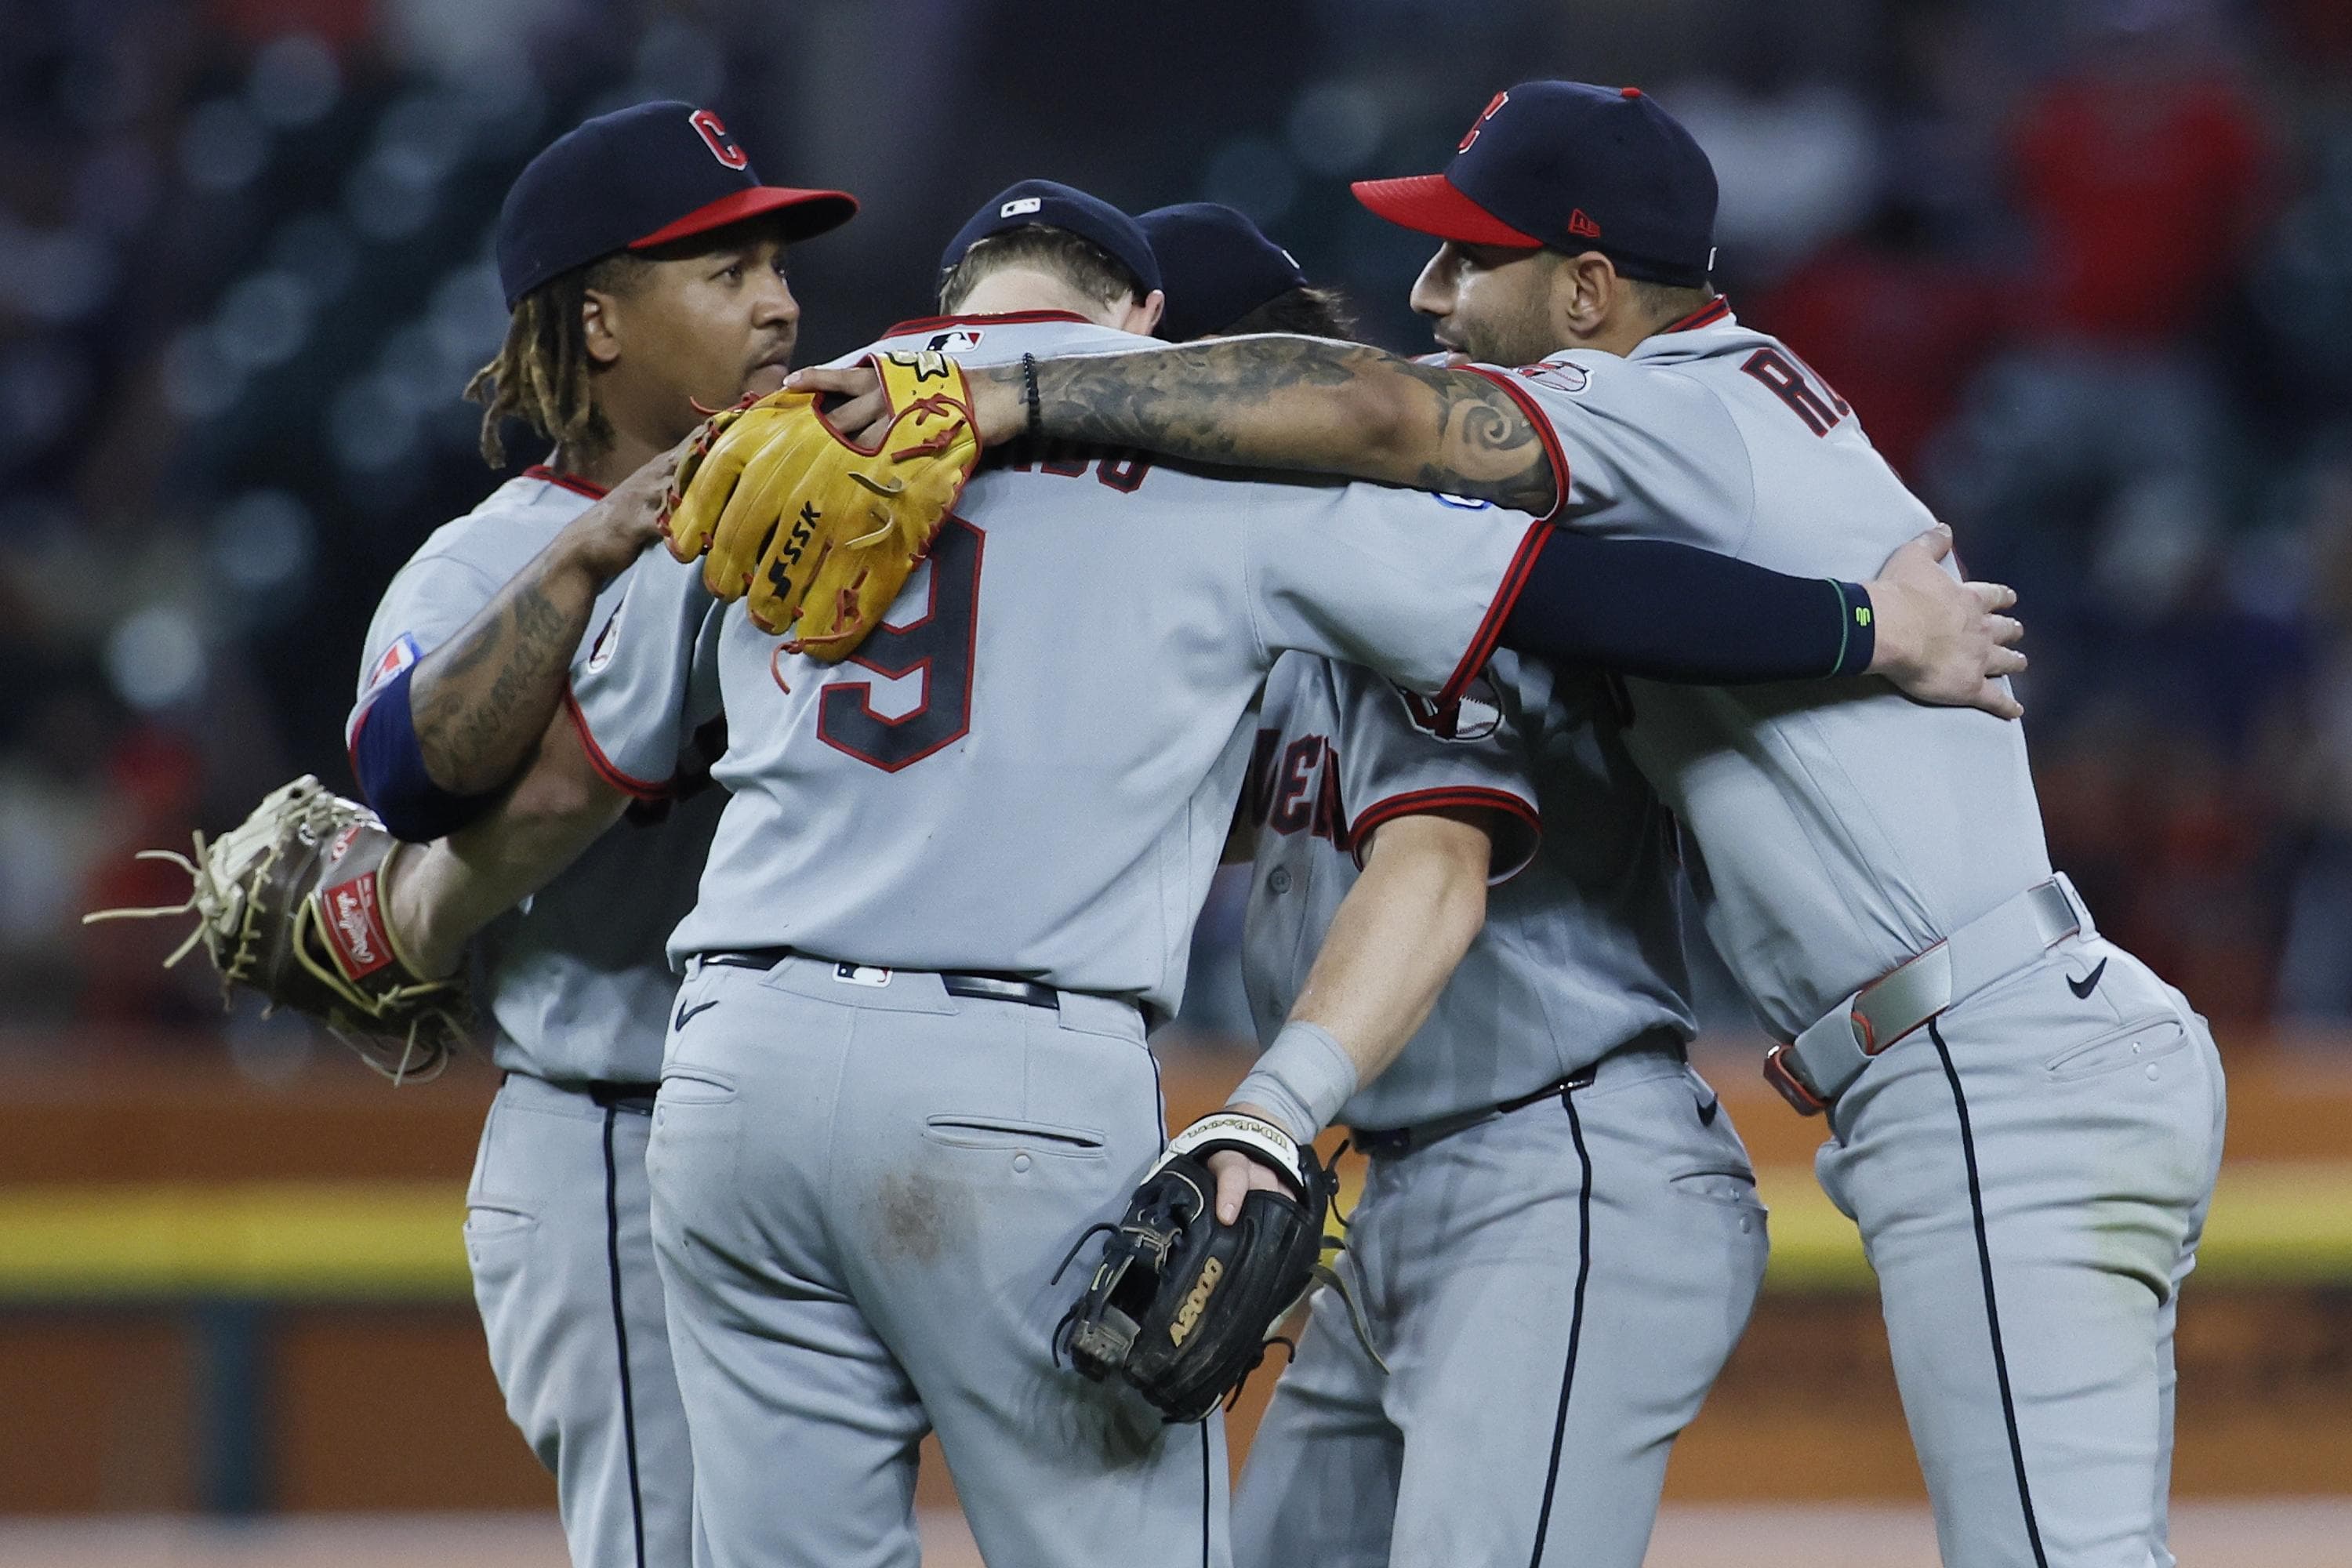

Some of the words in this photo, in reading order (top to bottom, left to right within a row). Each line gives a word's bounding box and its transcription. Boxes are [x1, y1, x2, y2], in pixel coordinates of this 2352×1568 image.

[688, 109, 749, 171] C
[1740, 347, 1850, 439] R
[817, 514, 986, 774] 9
[1170, 1256, 1225, 1348] A2000
